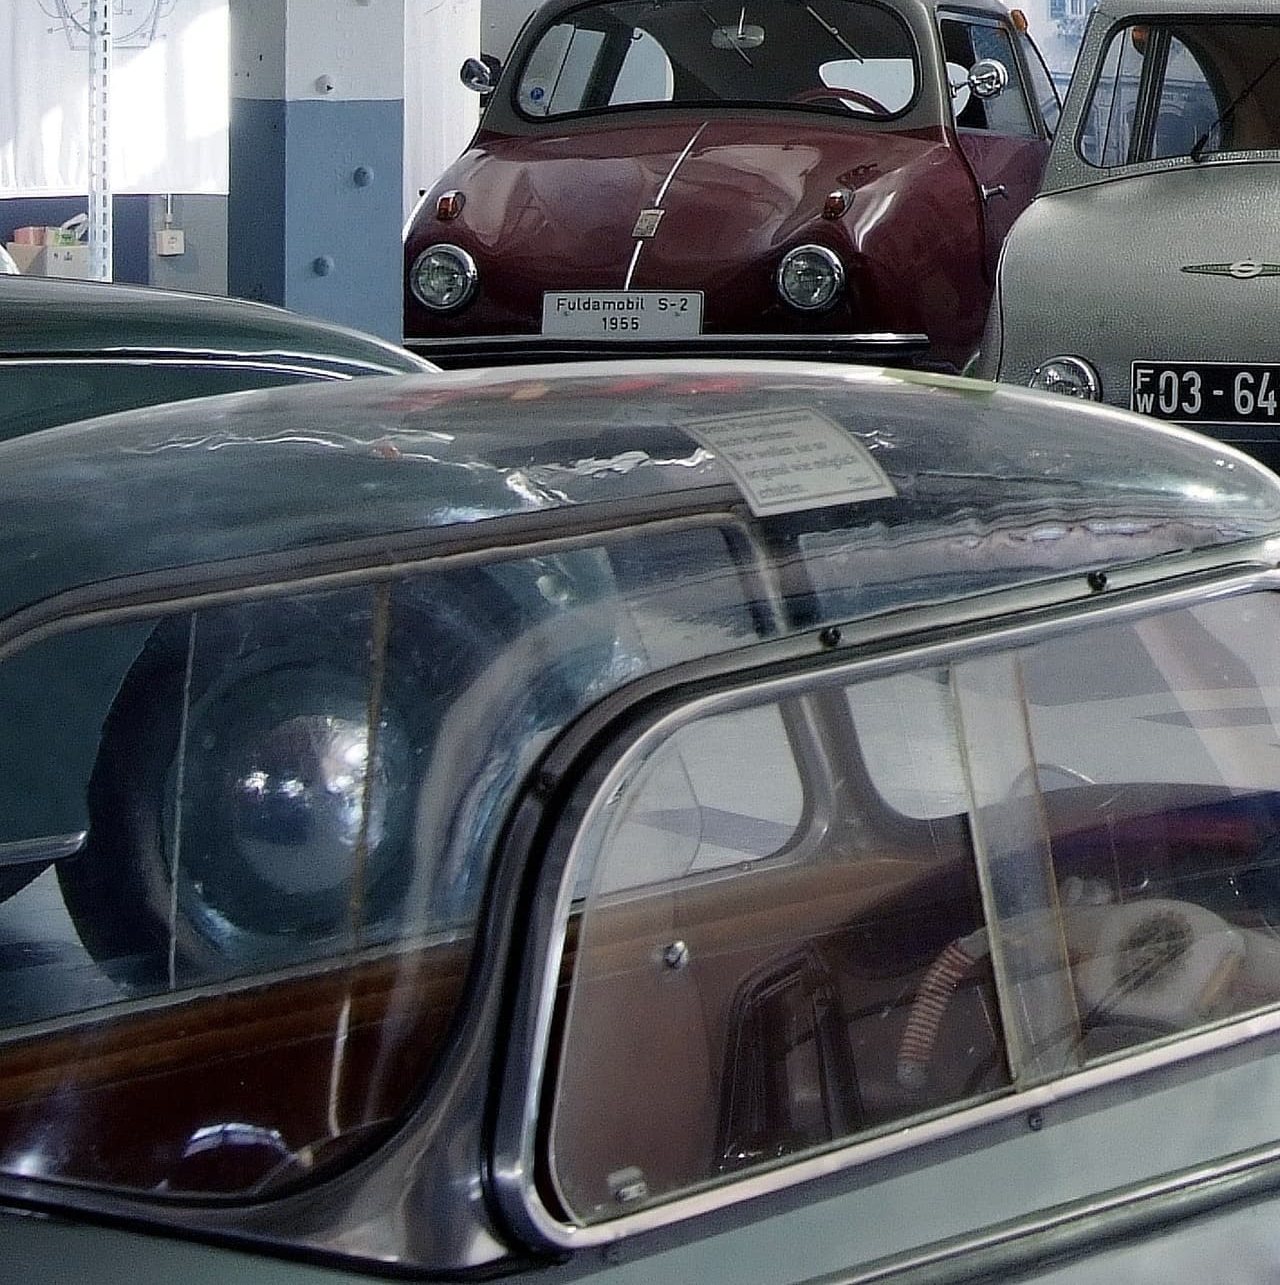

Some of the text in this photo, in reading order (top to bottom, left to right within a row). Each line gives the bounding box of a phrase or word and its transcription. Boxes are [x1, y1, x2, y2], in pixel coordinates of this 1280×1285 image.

[556, 297, 689, 312] Fuldamobil S-2
[602, 317, 639, 331] 1955
